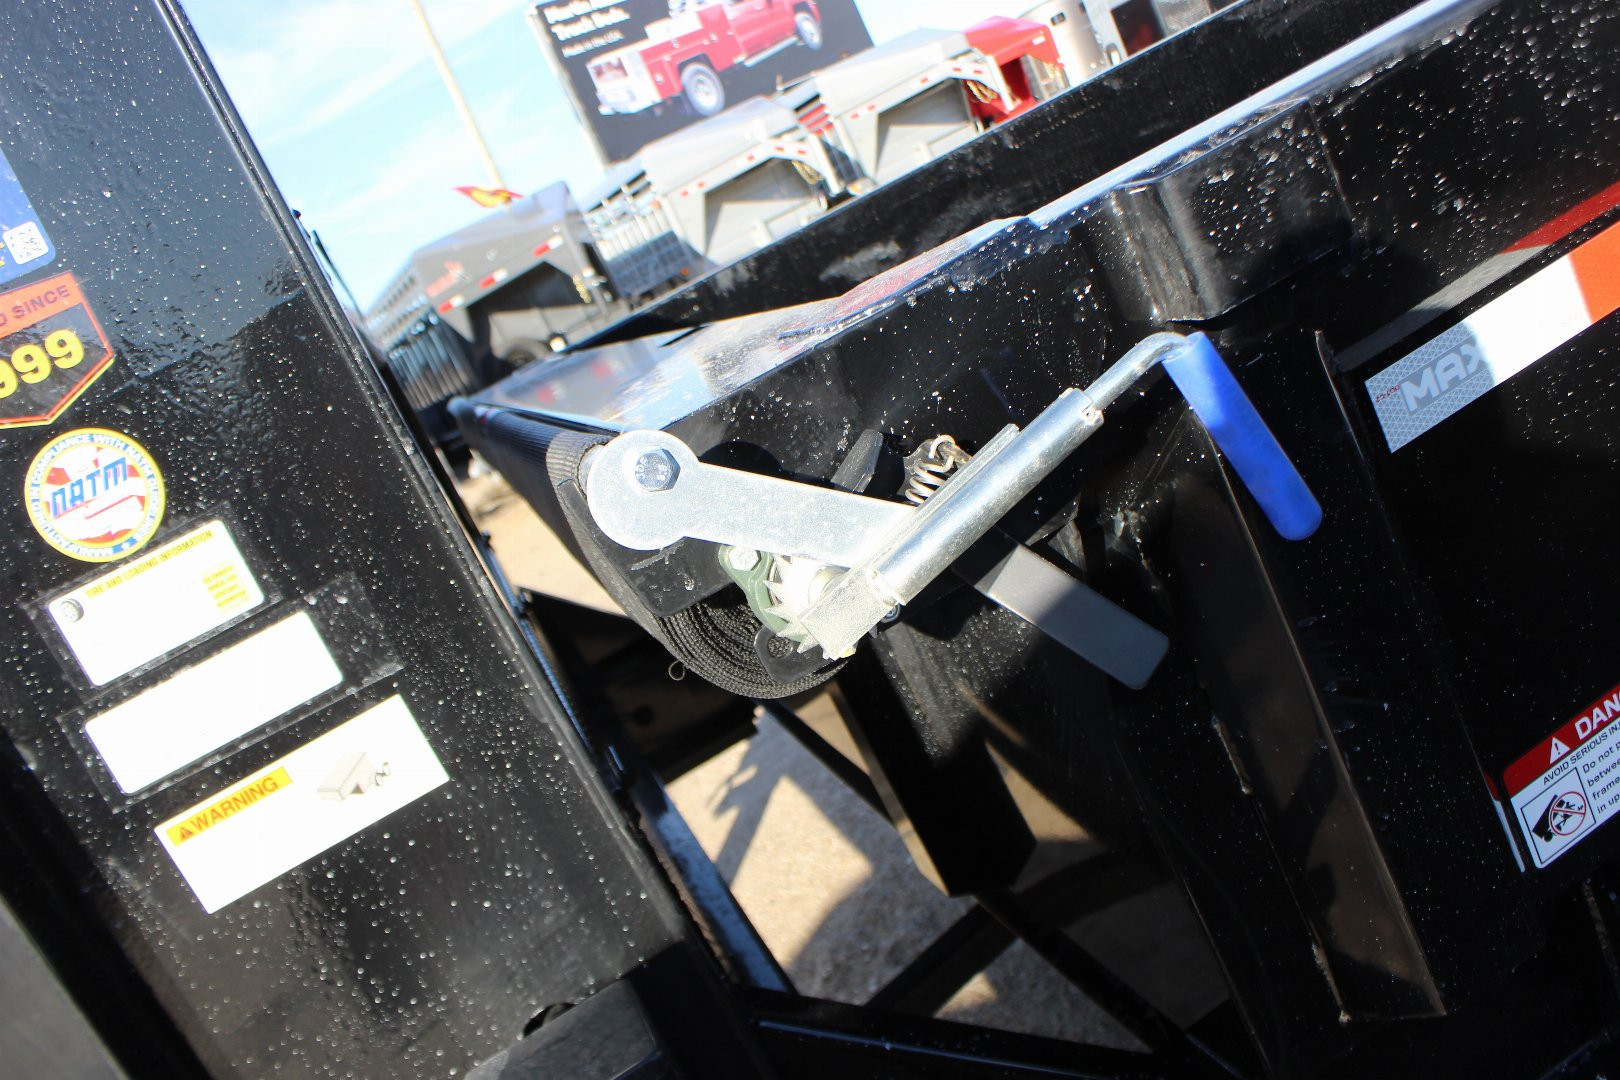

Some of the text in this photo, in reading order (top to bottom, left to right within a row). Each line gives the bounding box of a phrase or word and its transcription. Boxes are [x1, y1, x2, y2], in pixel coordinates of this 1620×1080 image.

[12, 285, 70, 318] SINCE
[51, 456, 128, 517] NATM
[124, 557, 158, 580] LOADING
[158, 530, 213, 561] INFORMATION
[1574, 691, 1620, 740] DAN
[1543, 761, 1569, 785] AVOID
[1570, 732, 1608, 764] SERIOUS
[1582, 761, 1596, 773] Do
[1598, 746, 1613, 761] not
[190, 777, 279, 832] WARNING
[1597, 802, 1607, 814] in
